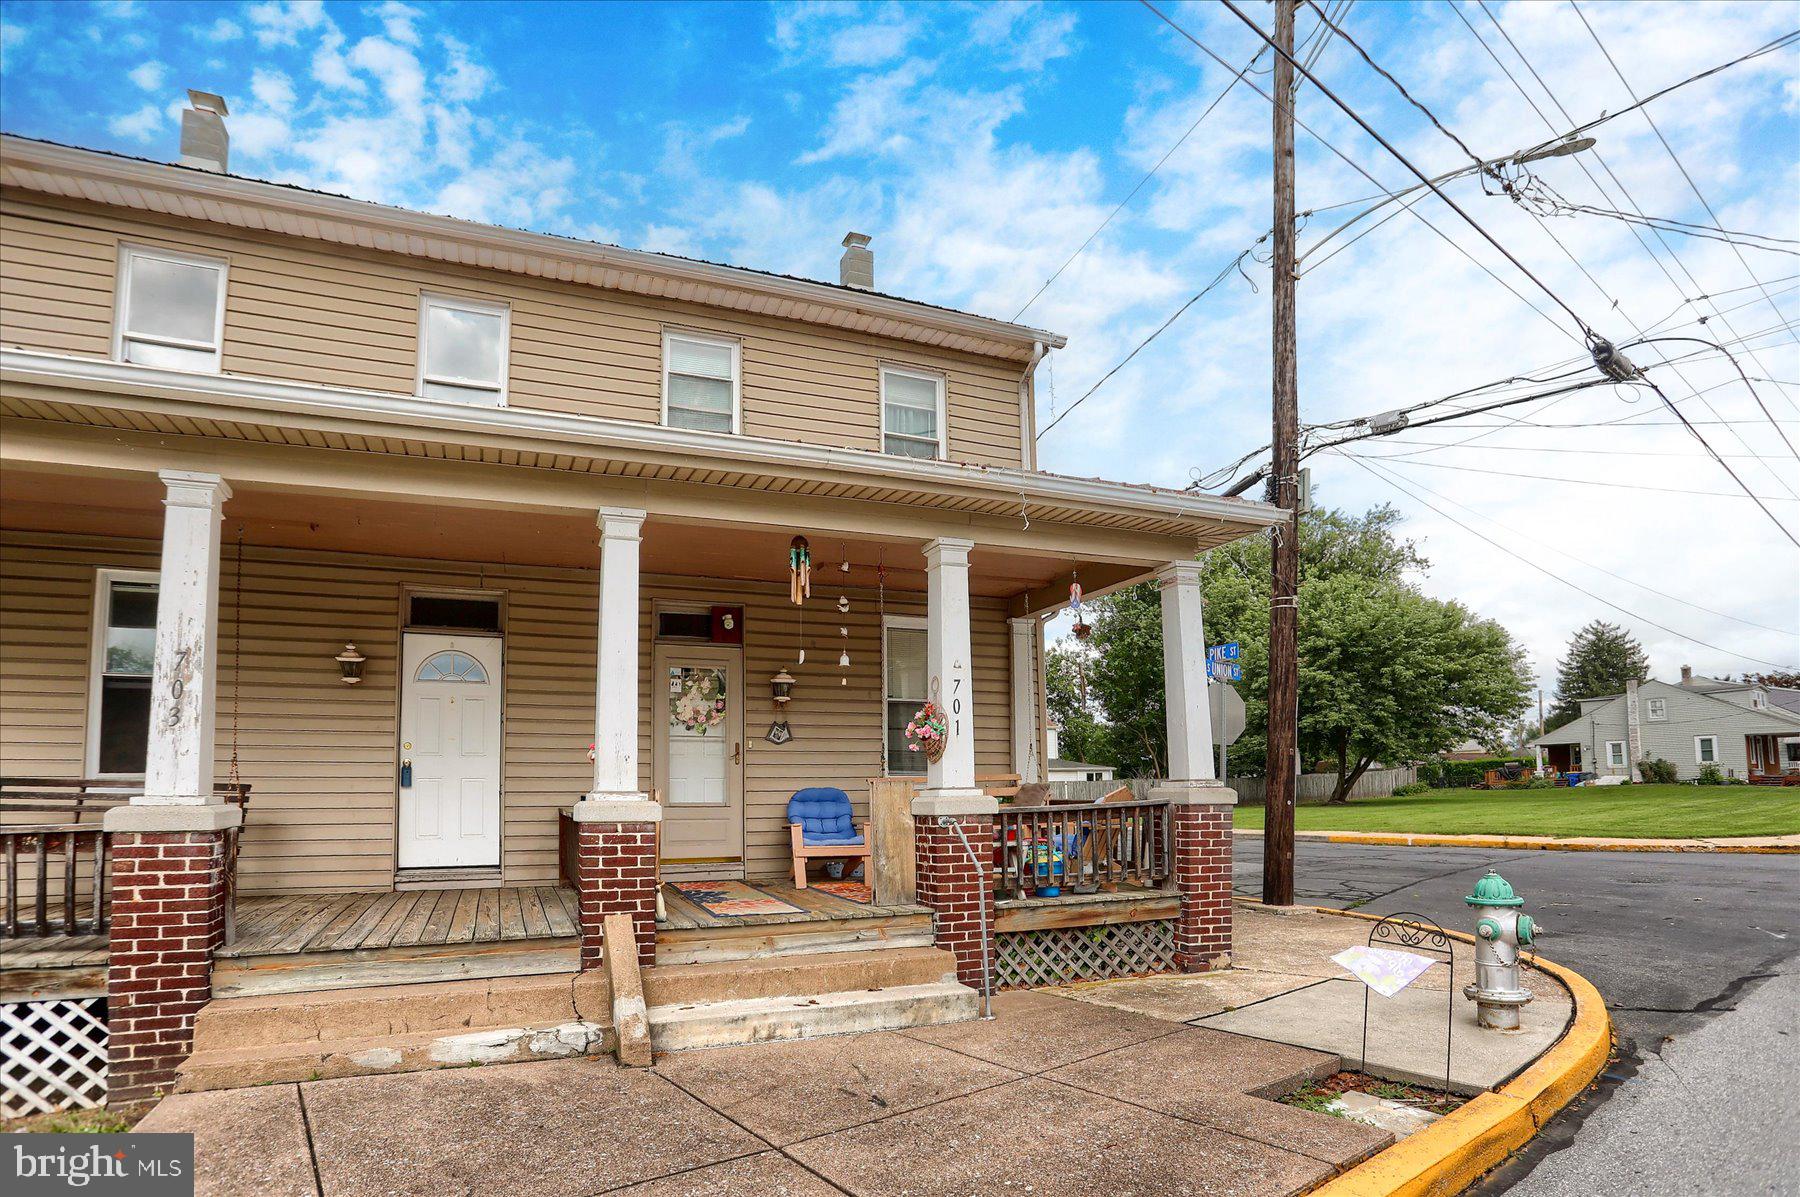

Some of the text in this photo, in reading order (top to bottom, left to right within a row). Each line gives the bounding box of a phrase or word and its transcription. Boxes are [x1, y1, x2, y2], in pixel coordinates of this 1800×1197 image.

[1209, 646, 1236, 660] PIKE ST
[1212, 662, 1232, 677] UNION
[1233, 667, 1239, 677] ST
[168, 651, 187, 727] 703
[952, 678, 961, 736] 701
